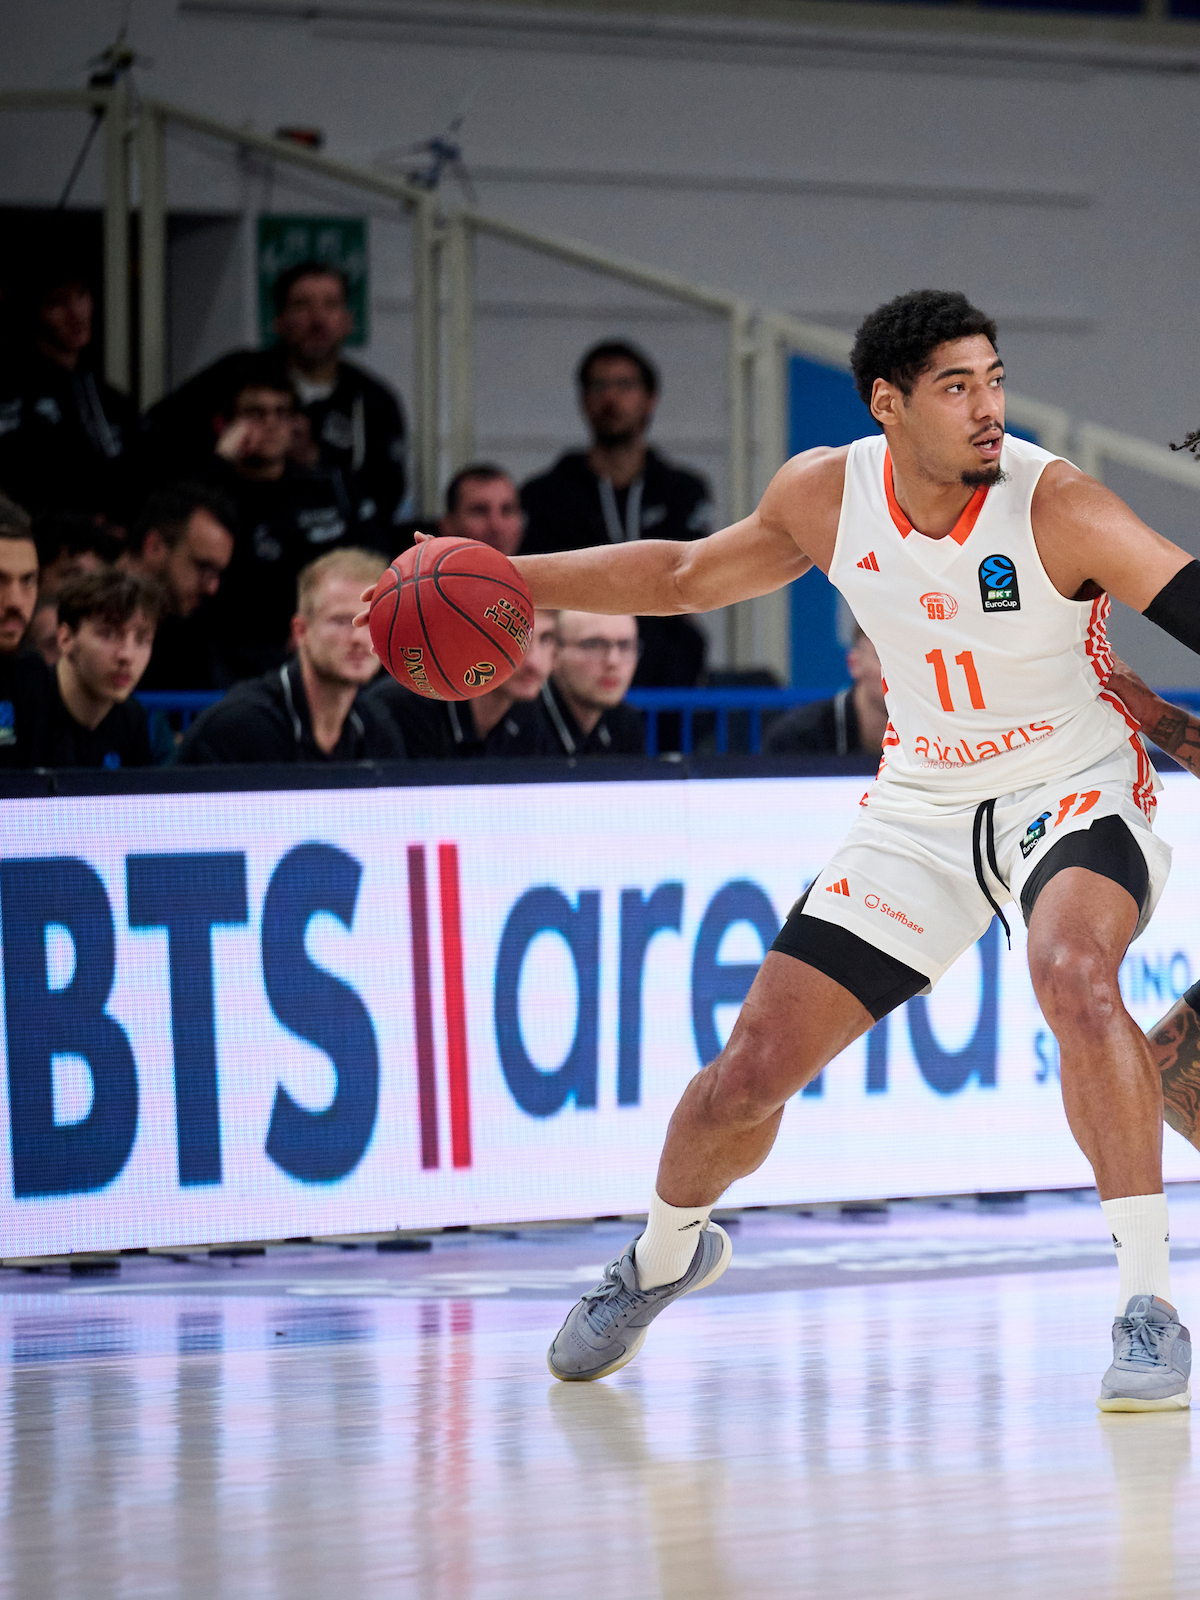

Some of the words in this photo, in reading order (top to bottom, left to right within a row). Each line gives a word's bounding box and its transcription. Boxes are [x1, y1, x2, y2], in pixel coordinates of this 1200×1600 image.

[985, 600, 1017, 609] EuroCup
[988, 590, 1012, 600] BKT
[927, 603, 945, 620] 99
[925, 648, 986, 712] 11
[1053, 790, 1102, 828] 11
[880, 903, 924, 935] Staffbase
[0, 840, 381, 1200] BTS
